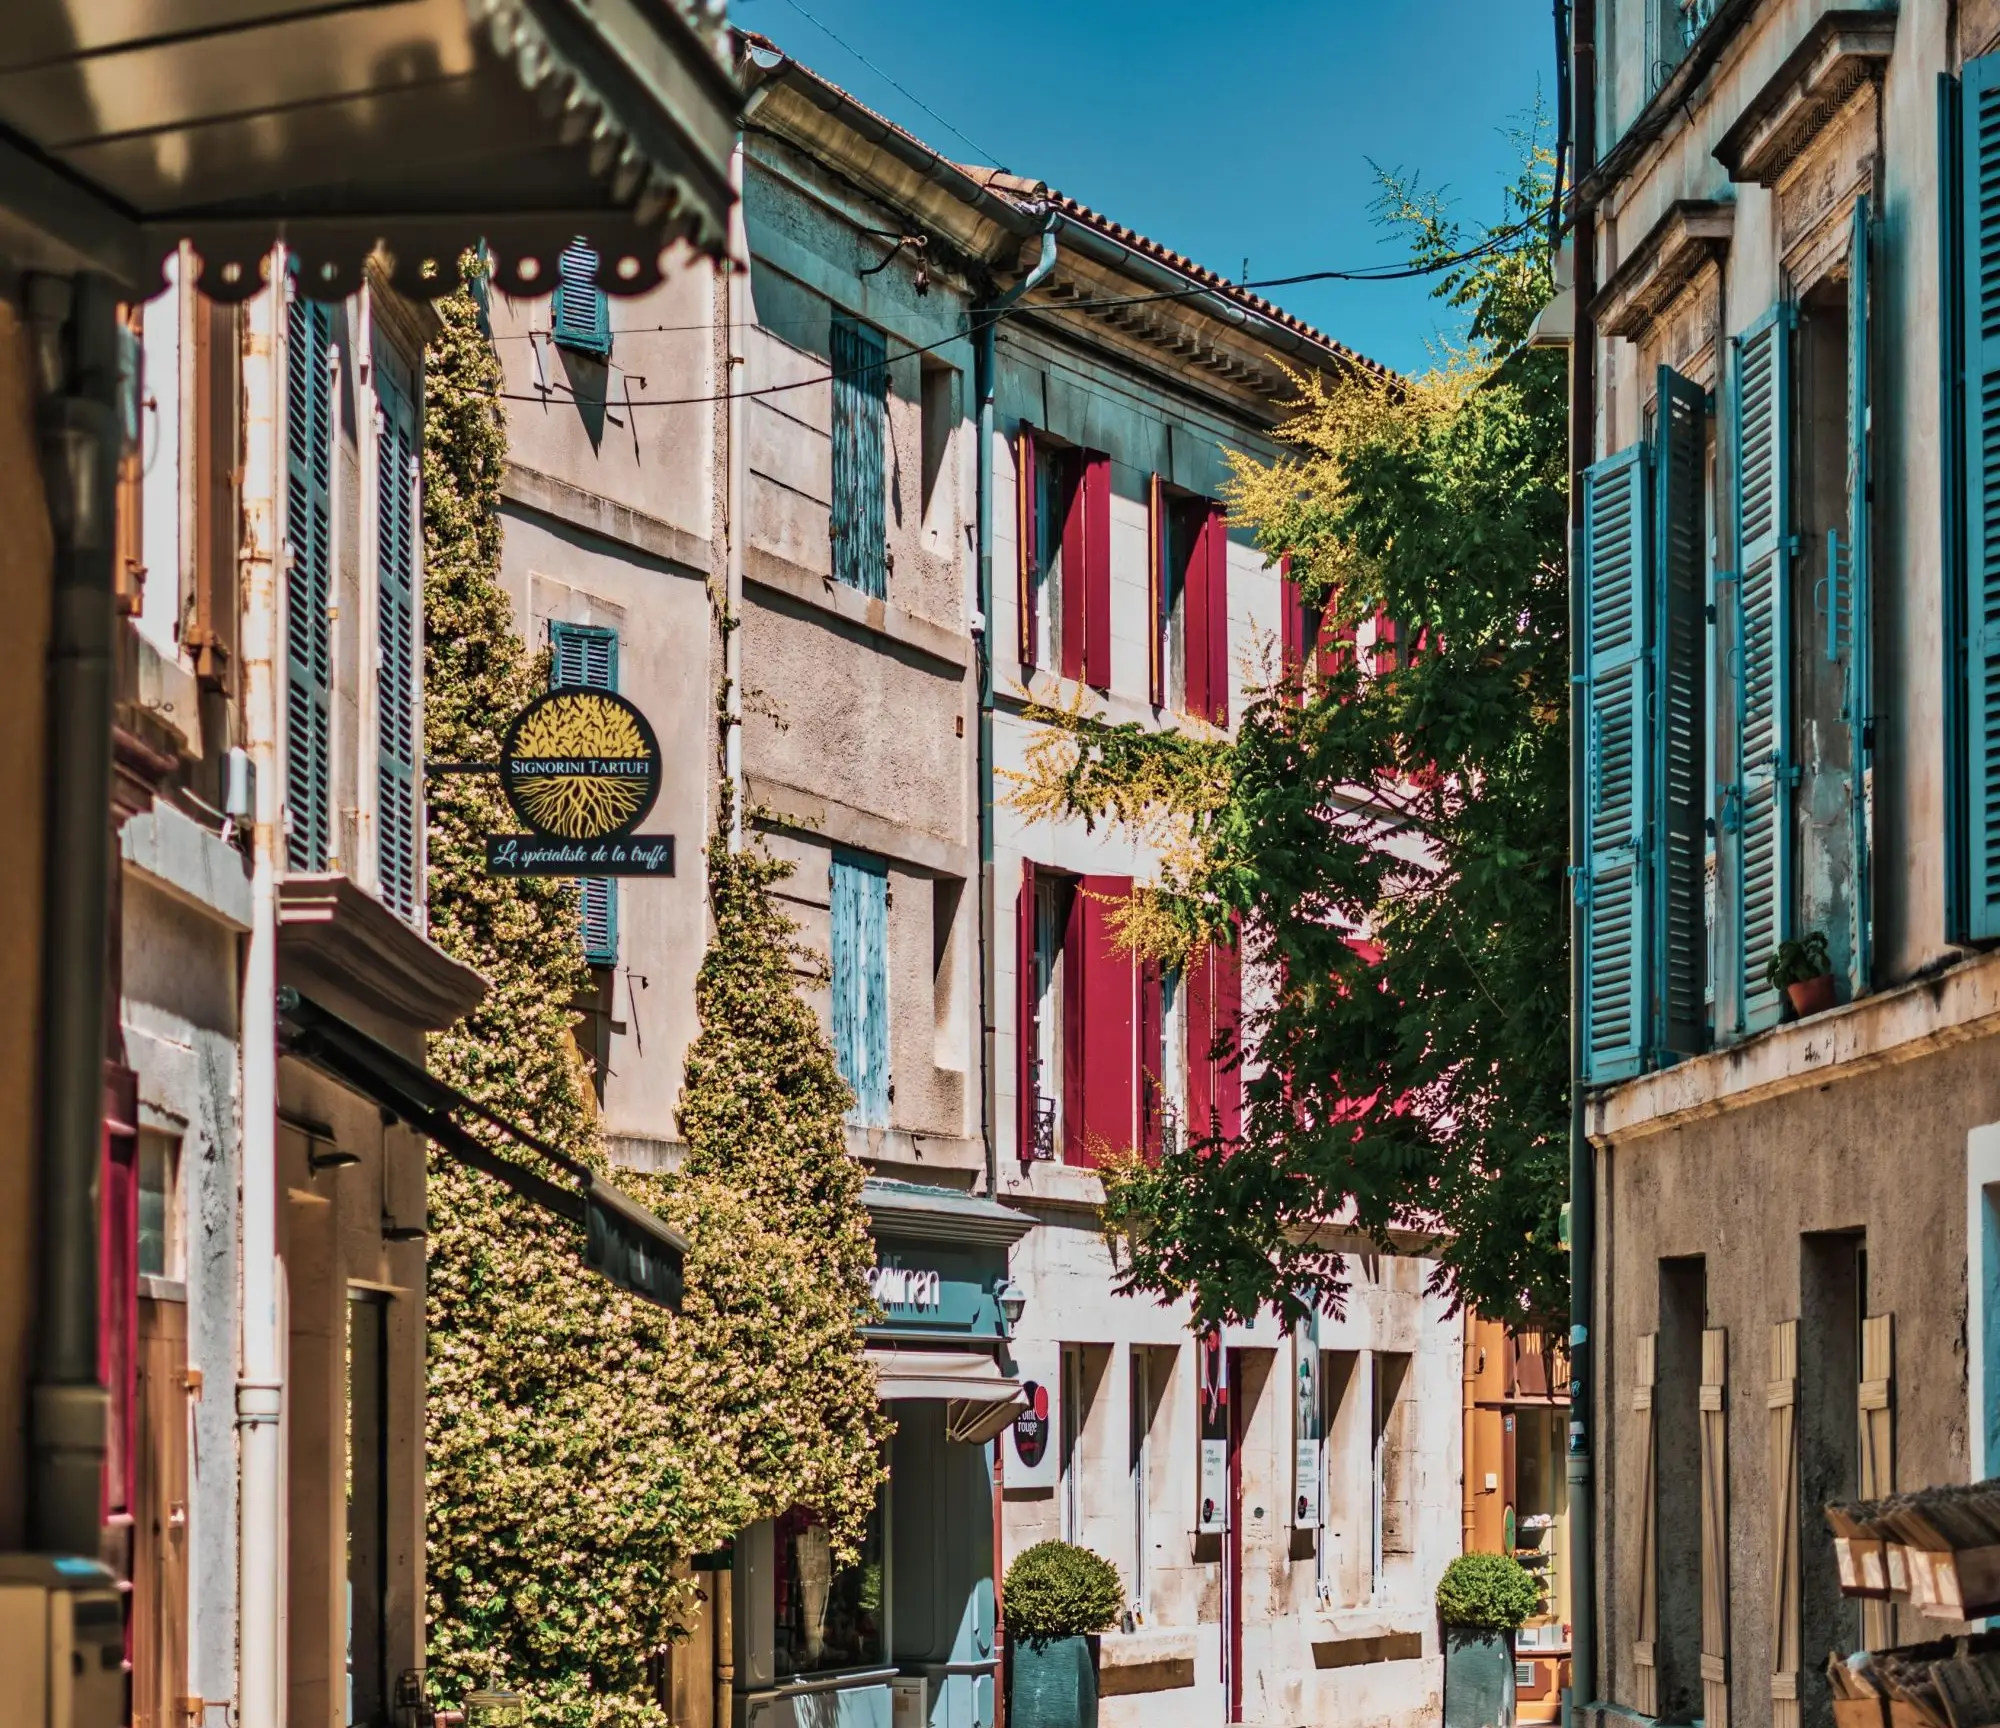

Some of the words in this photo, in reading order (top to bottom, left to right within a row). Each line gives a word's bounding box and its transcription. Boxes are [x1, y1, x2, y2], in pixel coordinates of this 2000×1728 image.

[511, 760, 585, 774] SIGNORINI
[589, 760, 649, 774] TARTUFI
[492, 840, 518, 868] Le
[521, 845, 588, 868] spécialiste
[591, 845, 608, 862] de
[611, 845, 627, 862] la
[630, 845, 668, 870] truffe
[1018, 1421, 1038, 1436] rouge
